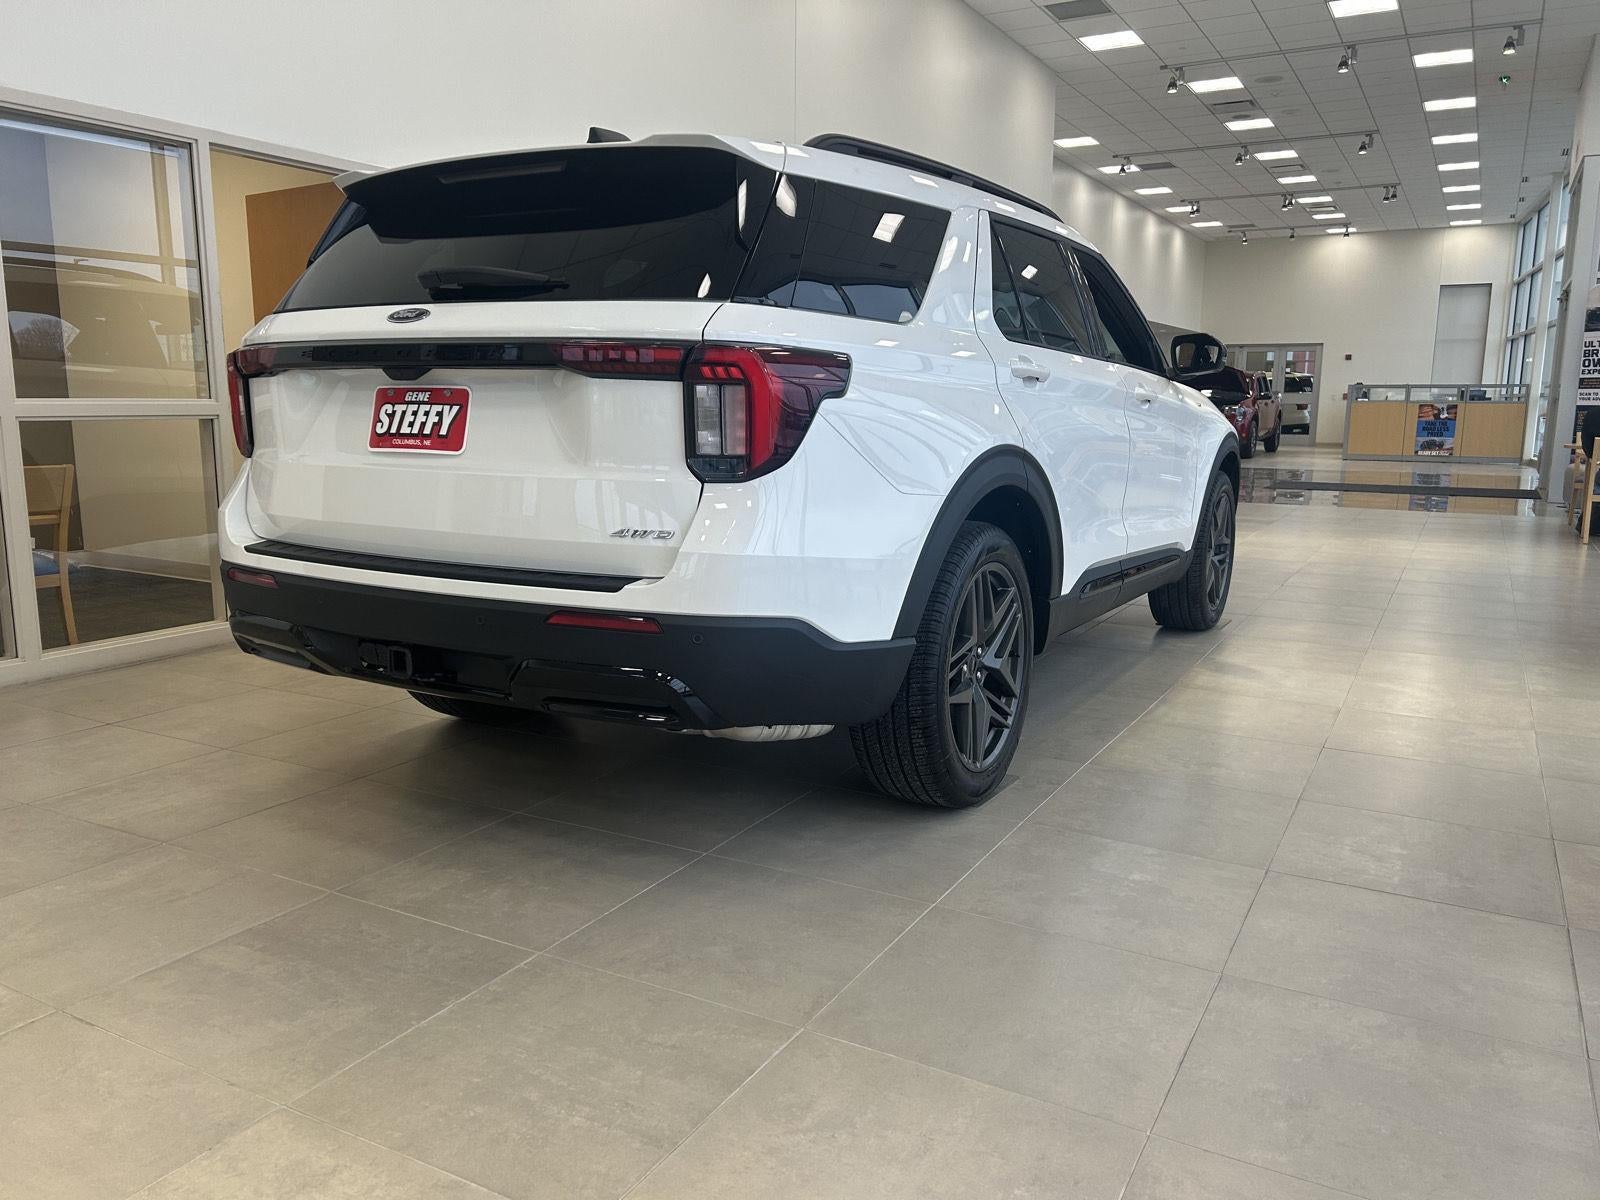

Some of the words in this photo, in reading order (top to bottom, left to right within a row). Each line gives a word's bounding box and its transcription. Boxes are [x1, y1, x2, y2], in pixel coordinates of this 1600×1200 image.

[393, 310, 420, 318] Ford
[404, 391, 432, 402] GENE
[375, 403, 462, 437] STEFFY
[392, 438, 422, 446] COLUMBUS,
[609, 528, 675, 540] 4WD
